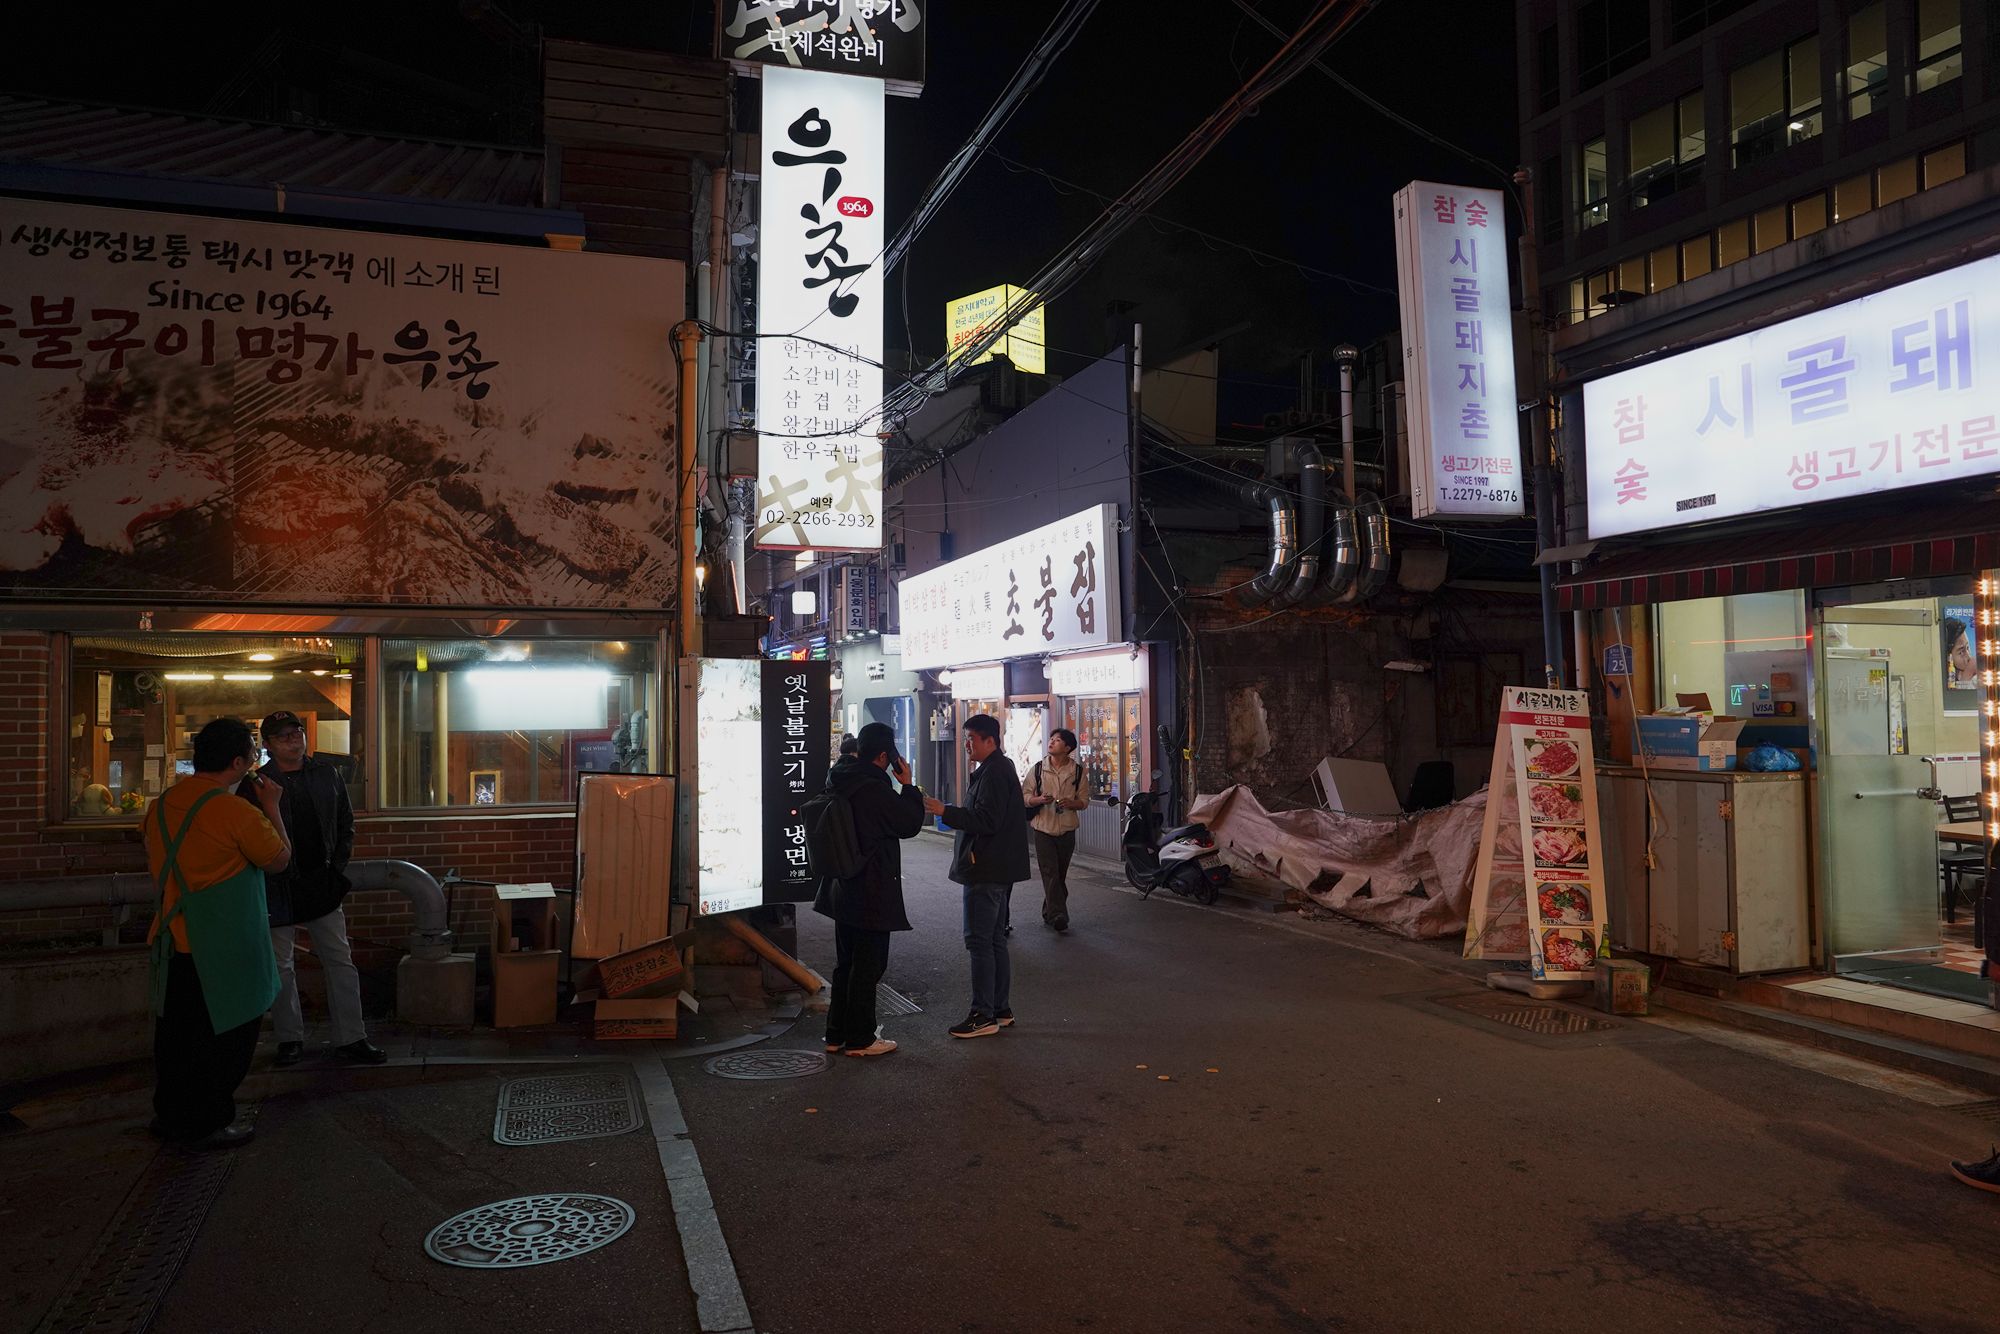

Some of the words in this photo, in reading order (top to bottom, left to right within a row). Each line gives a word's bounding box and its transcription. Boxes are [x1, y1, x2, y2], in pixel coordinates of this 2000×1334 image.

[765, 27, 884, 65] 단체석완비
[772, 107, 872, 317] 우촌
[843, 201, 868, 215] 1964
[1433, 195, 1489, 228] 참숯
[11, 225, 191, 269] 생생정보통
[202, 239, 272, 272] 택시
[283, 248, 353, 284] 맛객
[366, 258, 395, 288] 에
[147, 280, 244, 314] Since
[257, 288, 333, 321] 1964
[1449, 238, 1491, 440] 시골돼지촌
[240, 323, 374, 385] 명가
[383, 319, 499, 400] 우촌
[1695, 299, 1973, 438] 시골돼
[783, 365, 861, 389] 소갈비살
[782, 440, 861, 464] 한우국밥
[1613, 394, 1650, 505] 참숯
[1786, 414, 2000, 492] 생고기전문
[1441, 455, 1513, 475] 생고기전문
[1440, 487, 1518, 503] T.2279-6876
[1453, 475, 1473, 486] SINCE
[1474, 476, 1489, 487] 1997
[810, 497, 833, 508] 예약
[1676, 498, 1697, 512] SINCE
[1698, 494, 1717, 508] 1997
[766, 509, 875, 528] 02-2266-2932
[1612, 660, 1625, 672] 25
[1517, 691, 1579, 711] 시골돼지촌
[1756, 704, 1774, 712] VISA
[782, 674, 809, 780] 옛날불고기
[783, 825, 808, 866] 냉면
